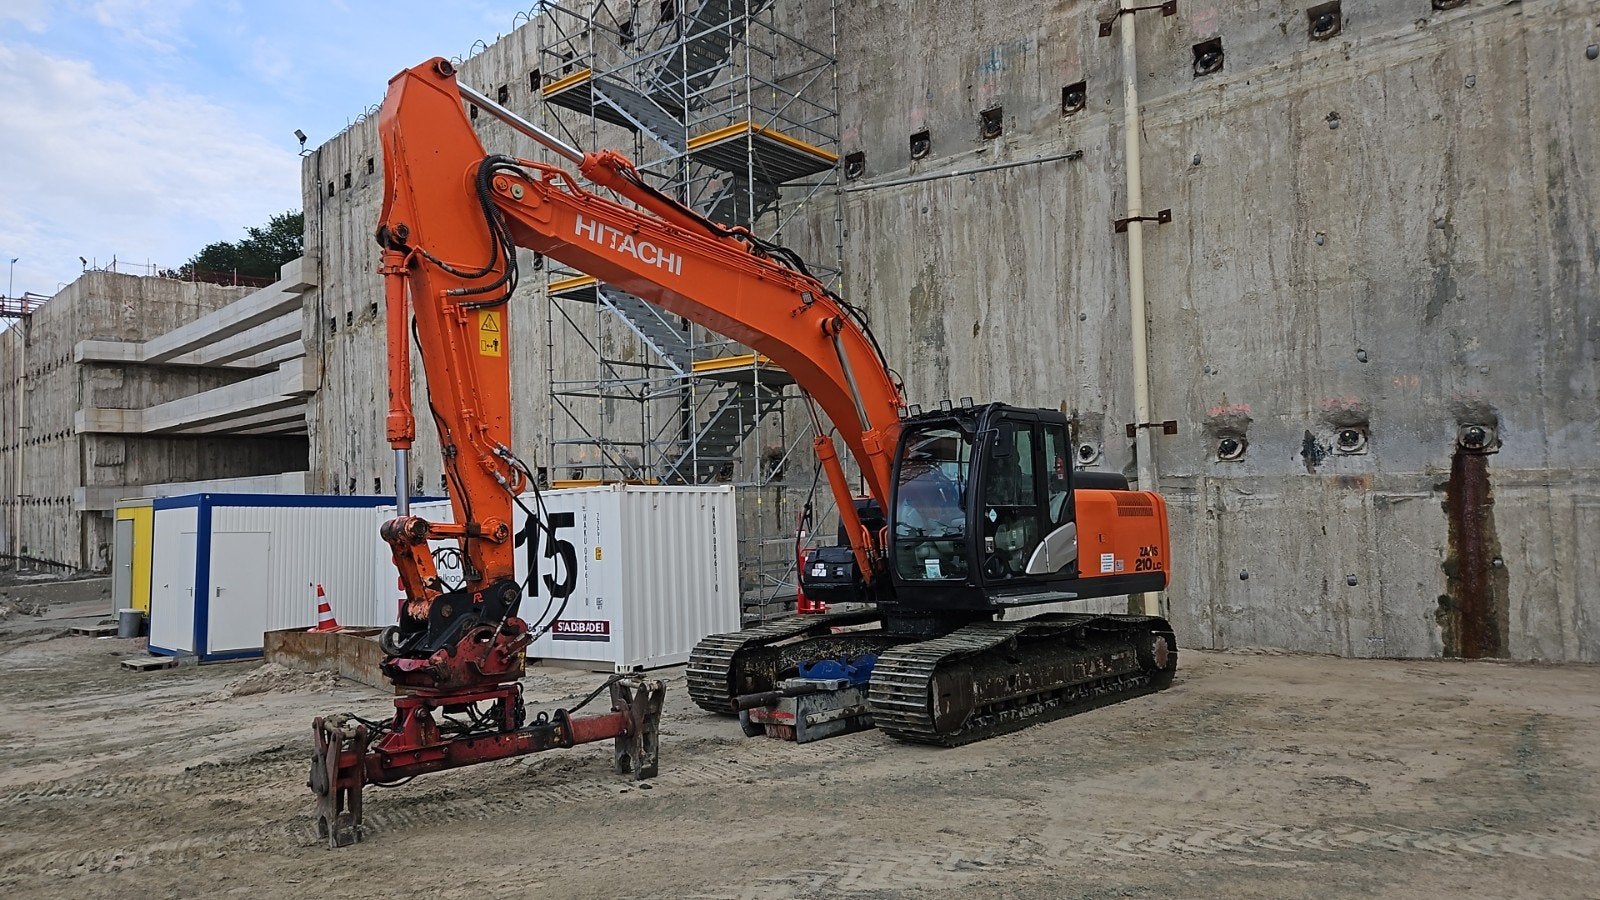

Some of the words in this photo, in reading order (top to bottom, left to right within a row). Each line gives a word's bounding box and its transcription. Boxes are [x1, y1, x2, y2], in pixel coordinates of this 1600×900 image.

[575, 214, 682, 276] HITACHI
[515, 512, 577, 598] 15
[1135, 558, 1152, 571] 210
[1153, 562, 1162, 570] LC
